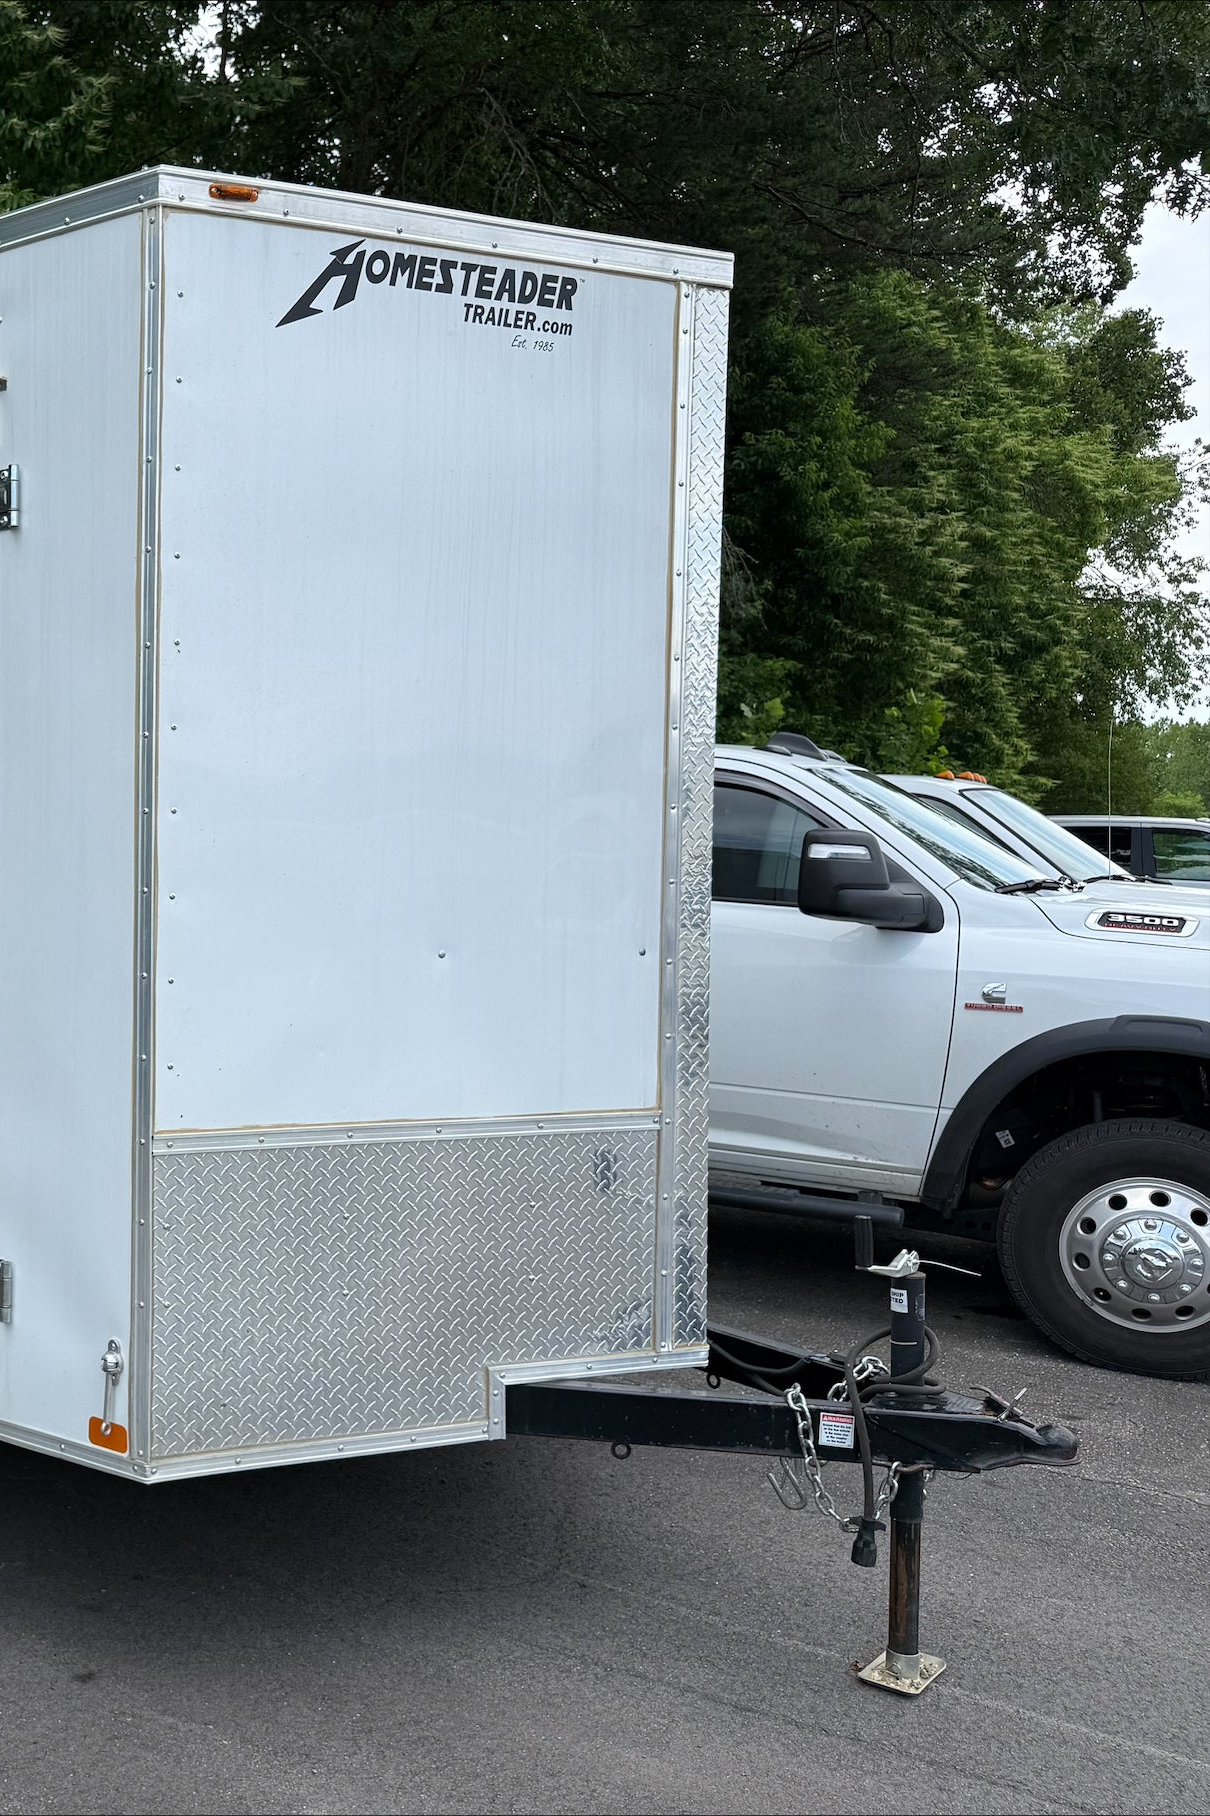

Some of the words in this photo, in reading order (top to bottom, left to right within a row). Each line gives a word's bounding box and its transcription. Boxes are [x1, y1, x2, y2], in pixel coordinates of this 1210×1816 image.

[275, 238, 578, 328] HOMESTEADER
[463, 302, 573, 336] TRAILER.com
[511, 334, 528, 350] Est.
[533, 340, 555, 352] 1985
[1108, 913, 1179, 927] 3500
